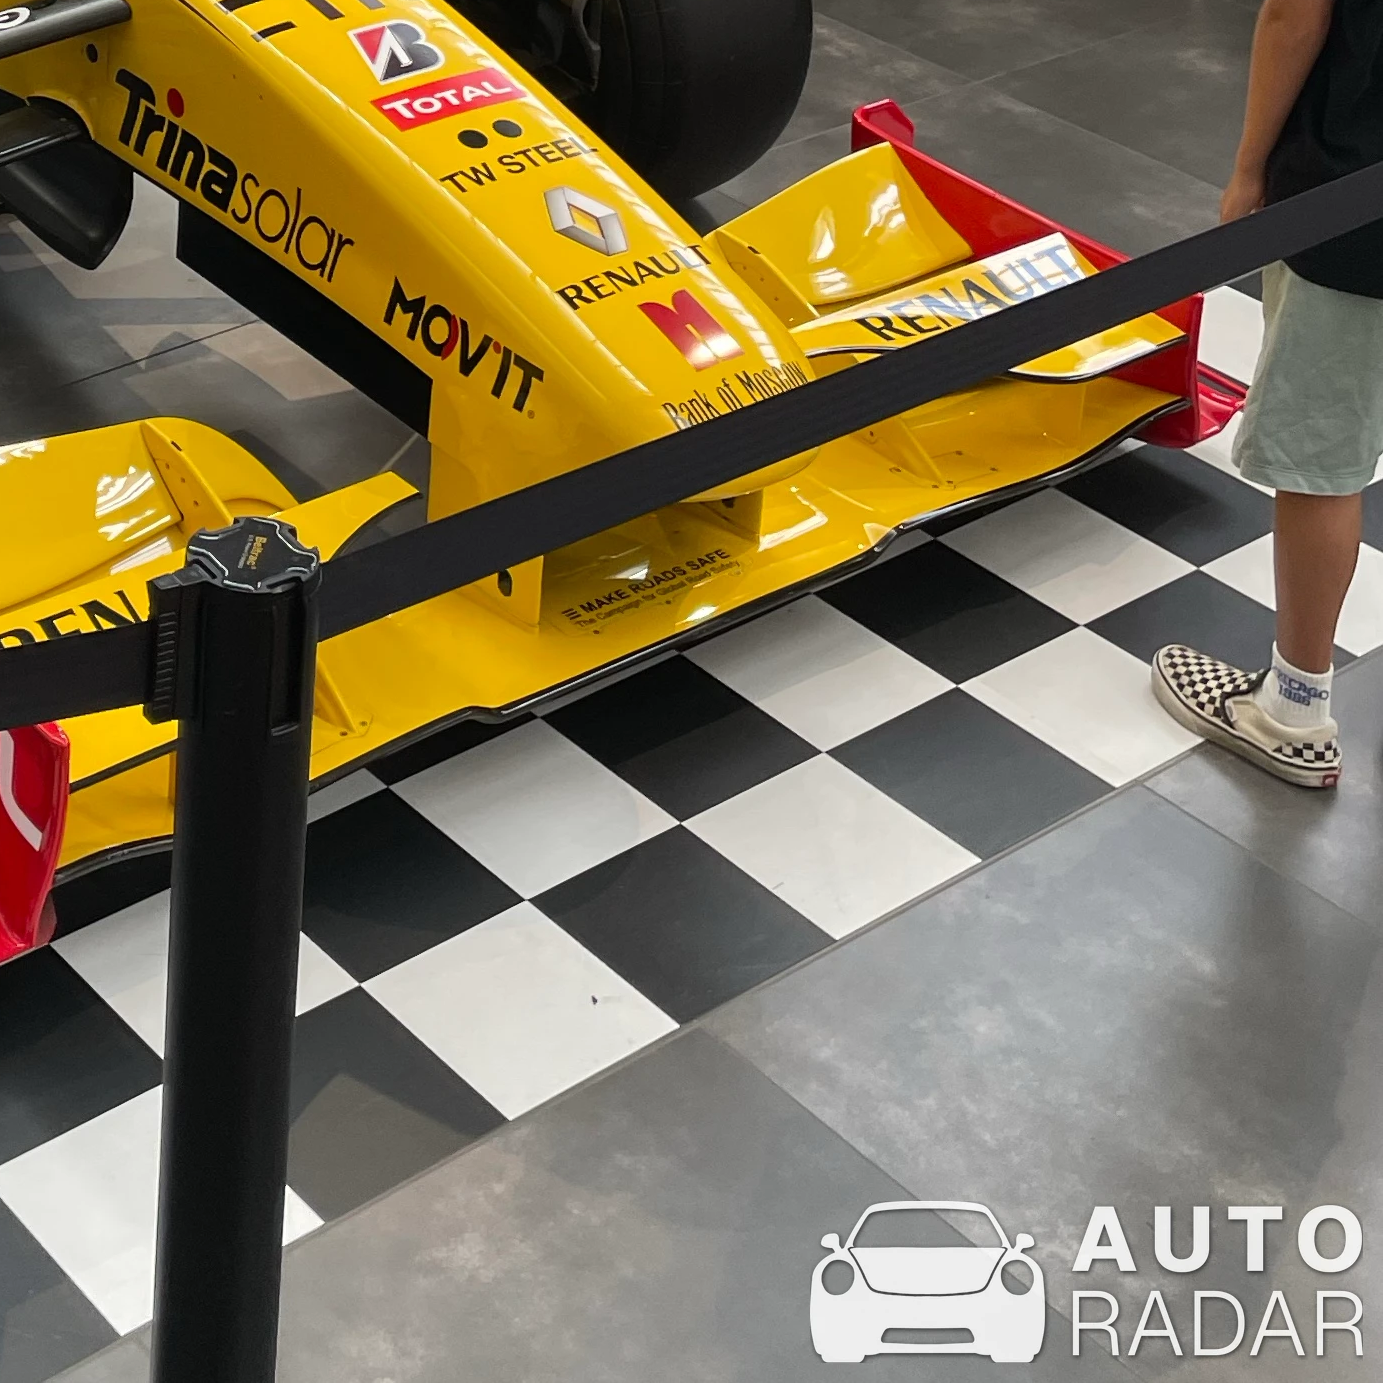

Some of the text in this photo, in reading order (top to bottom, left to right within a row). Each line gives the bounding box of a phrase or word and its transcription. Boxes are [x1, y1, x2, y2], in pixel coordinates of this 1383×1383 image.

[380, 75, 515, 121] TOTAL
[439, 136, 599, 194] TW STEEL
[555, 243, 713, 312] RENAULT
[852, 243, 1082, 342] RENAULT
[716, 377, 745, 413] of
[579, 548, 731, 614] MAKE ROADS SAFE
